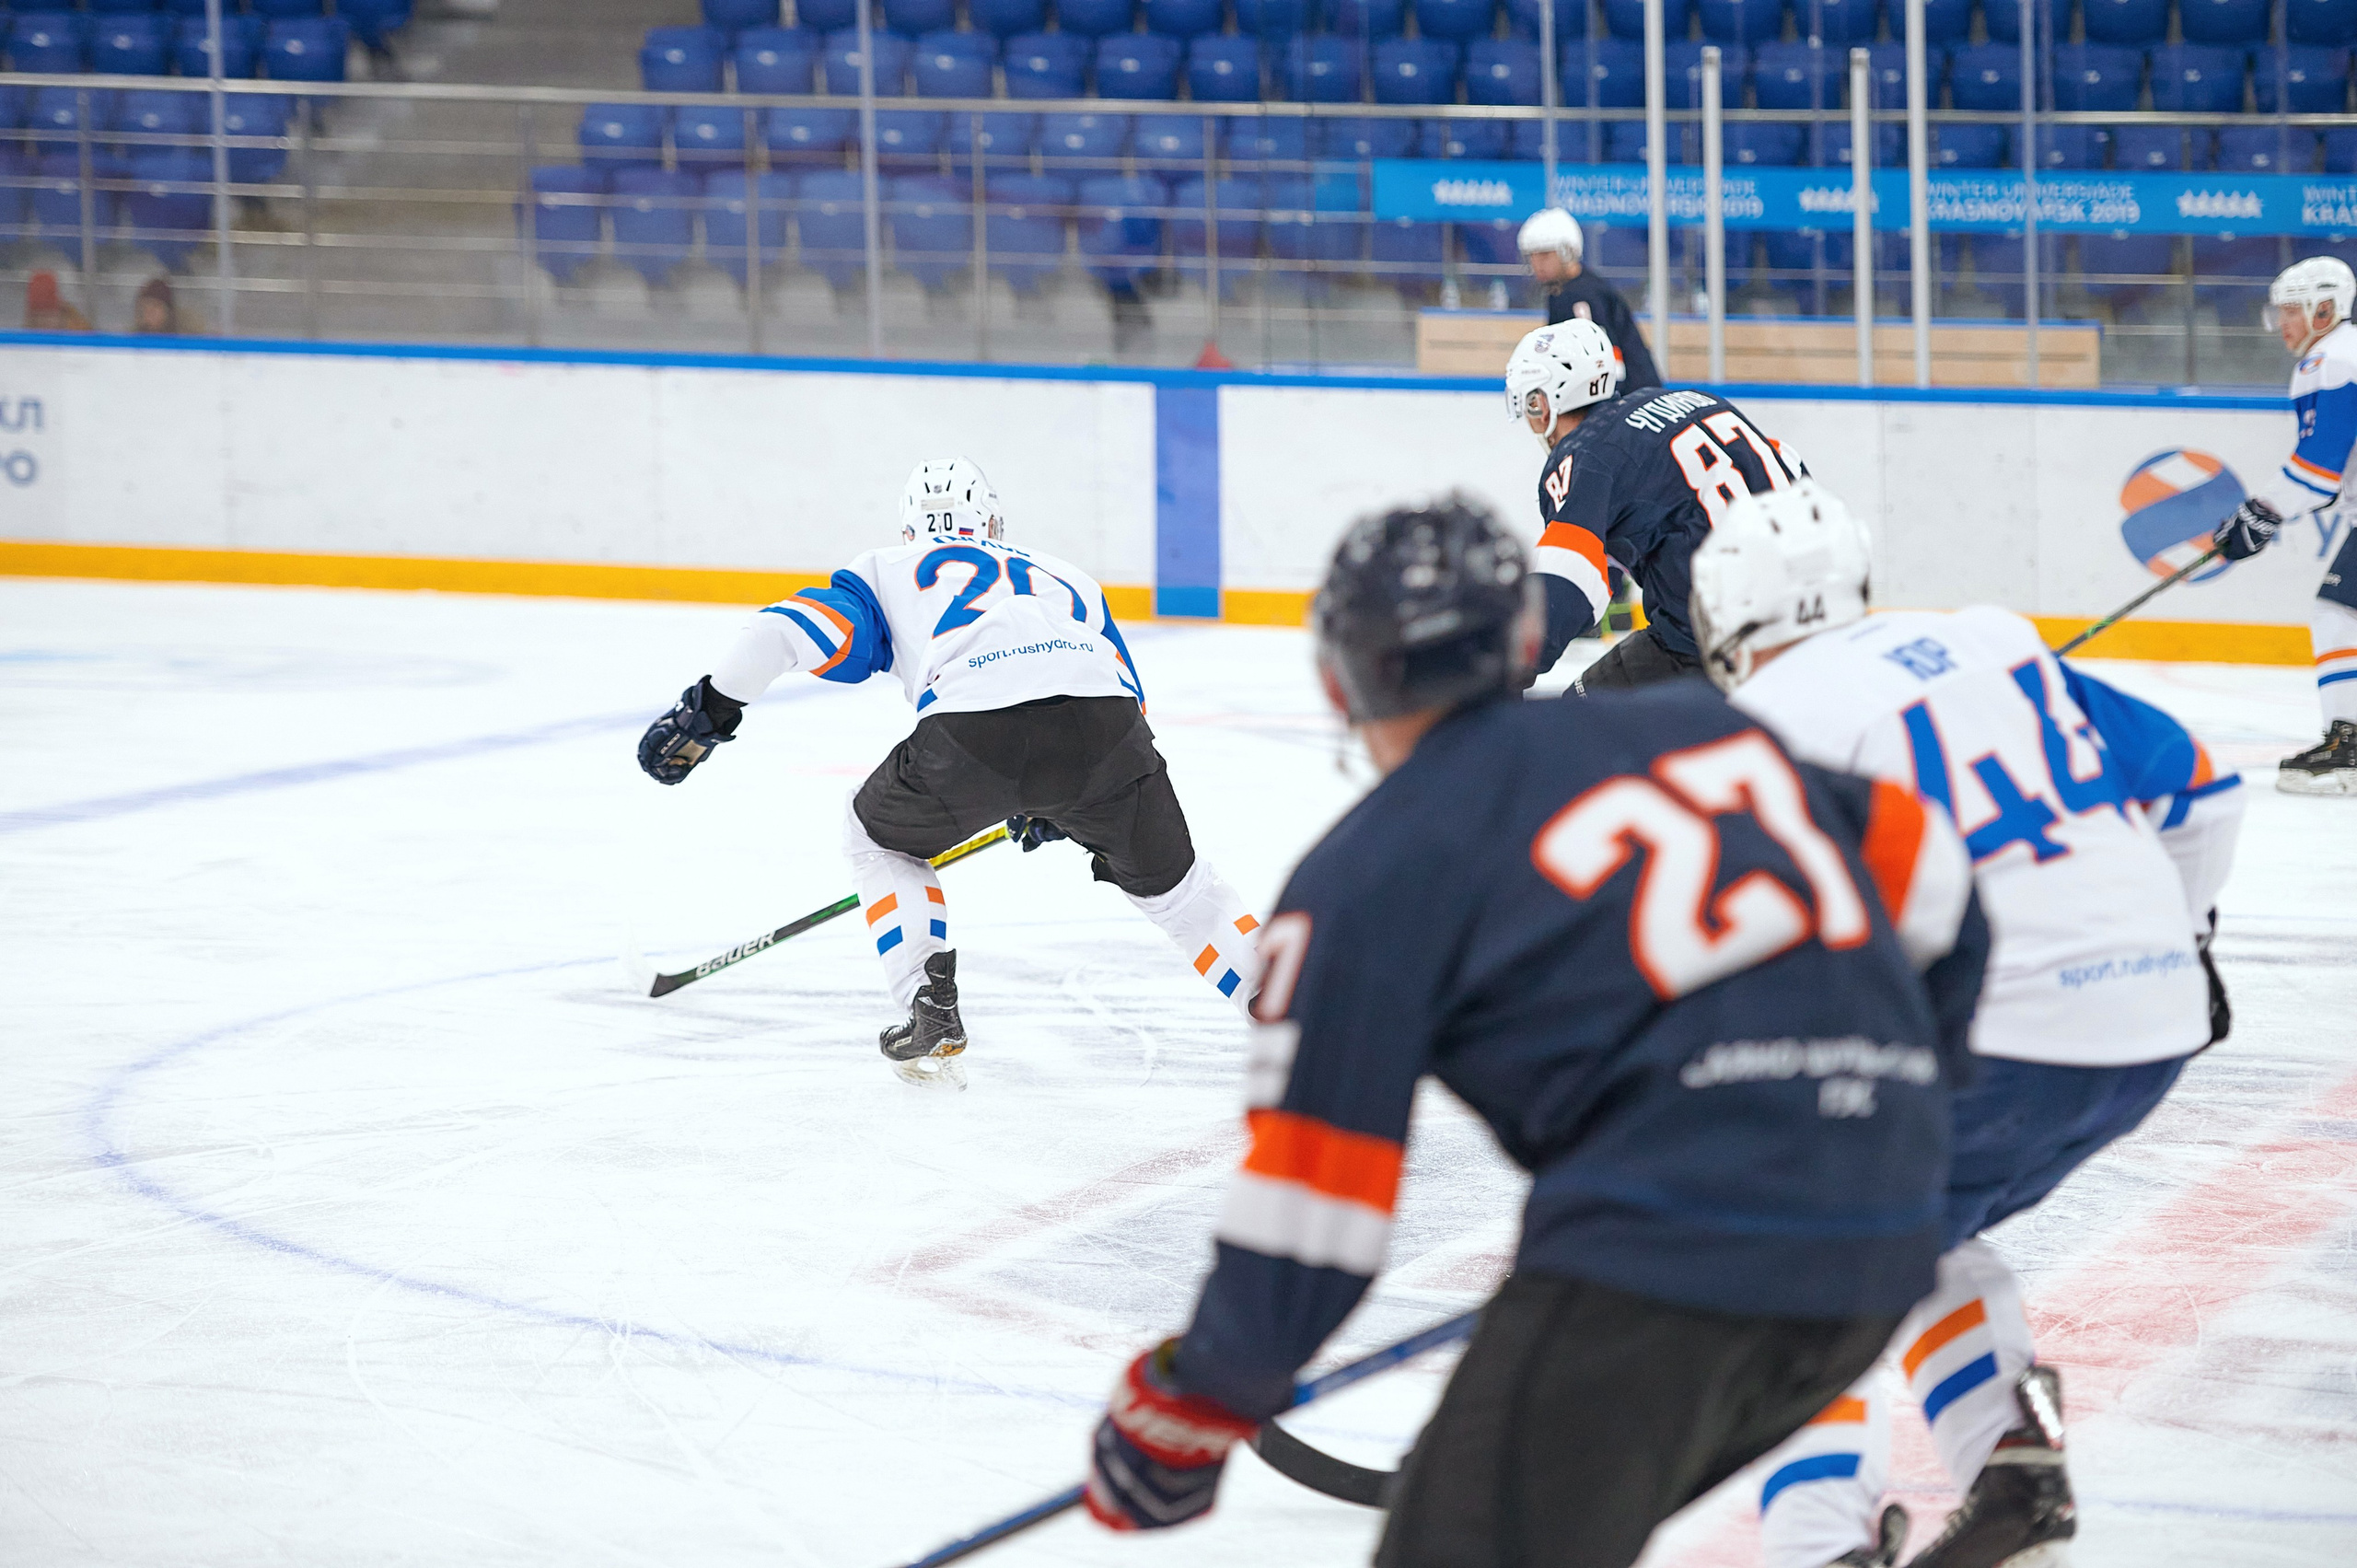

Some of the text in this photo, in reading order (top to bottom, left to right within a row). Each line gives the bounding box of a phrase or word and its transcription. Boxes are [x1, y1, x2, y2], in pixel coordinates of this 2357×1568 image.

[1589, 372, 1609, 396] 87
[1669, 411, 1794, 532] 87
[926, 512, 953, 533] 20
[914, 544, 1088, 640] 20
[1795, 594, 1827, 626] 44
[967, 637, 1095, 669] sport.rushydro.ru
[1530, 726, 1872, 1003] 27
